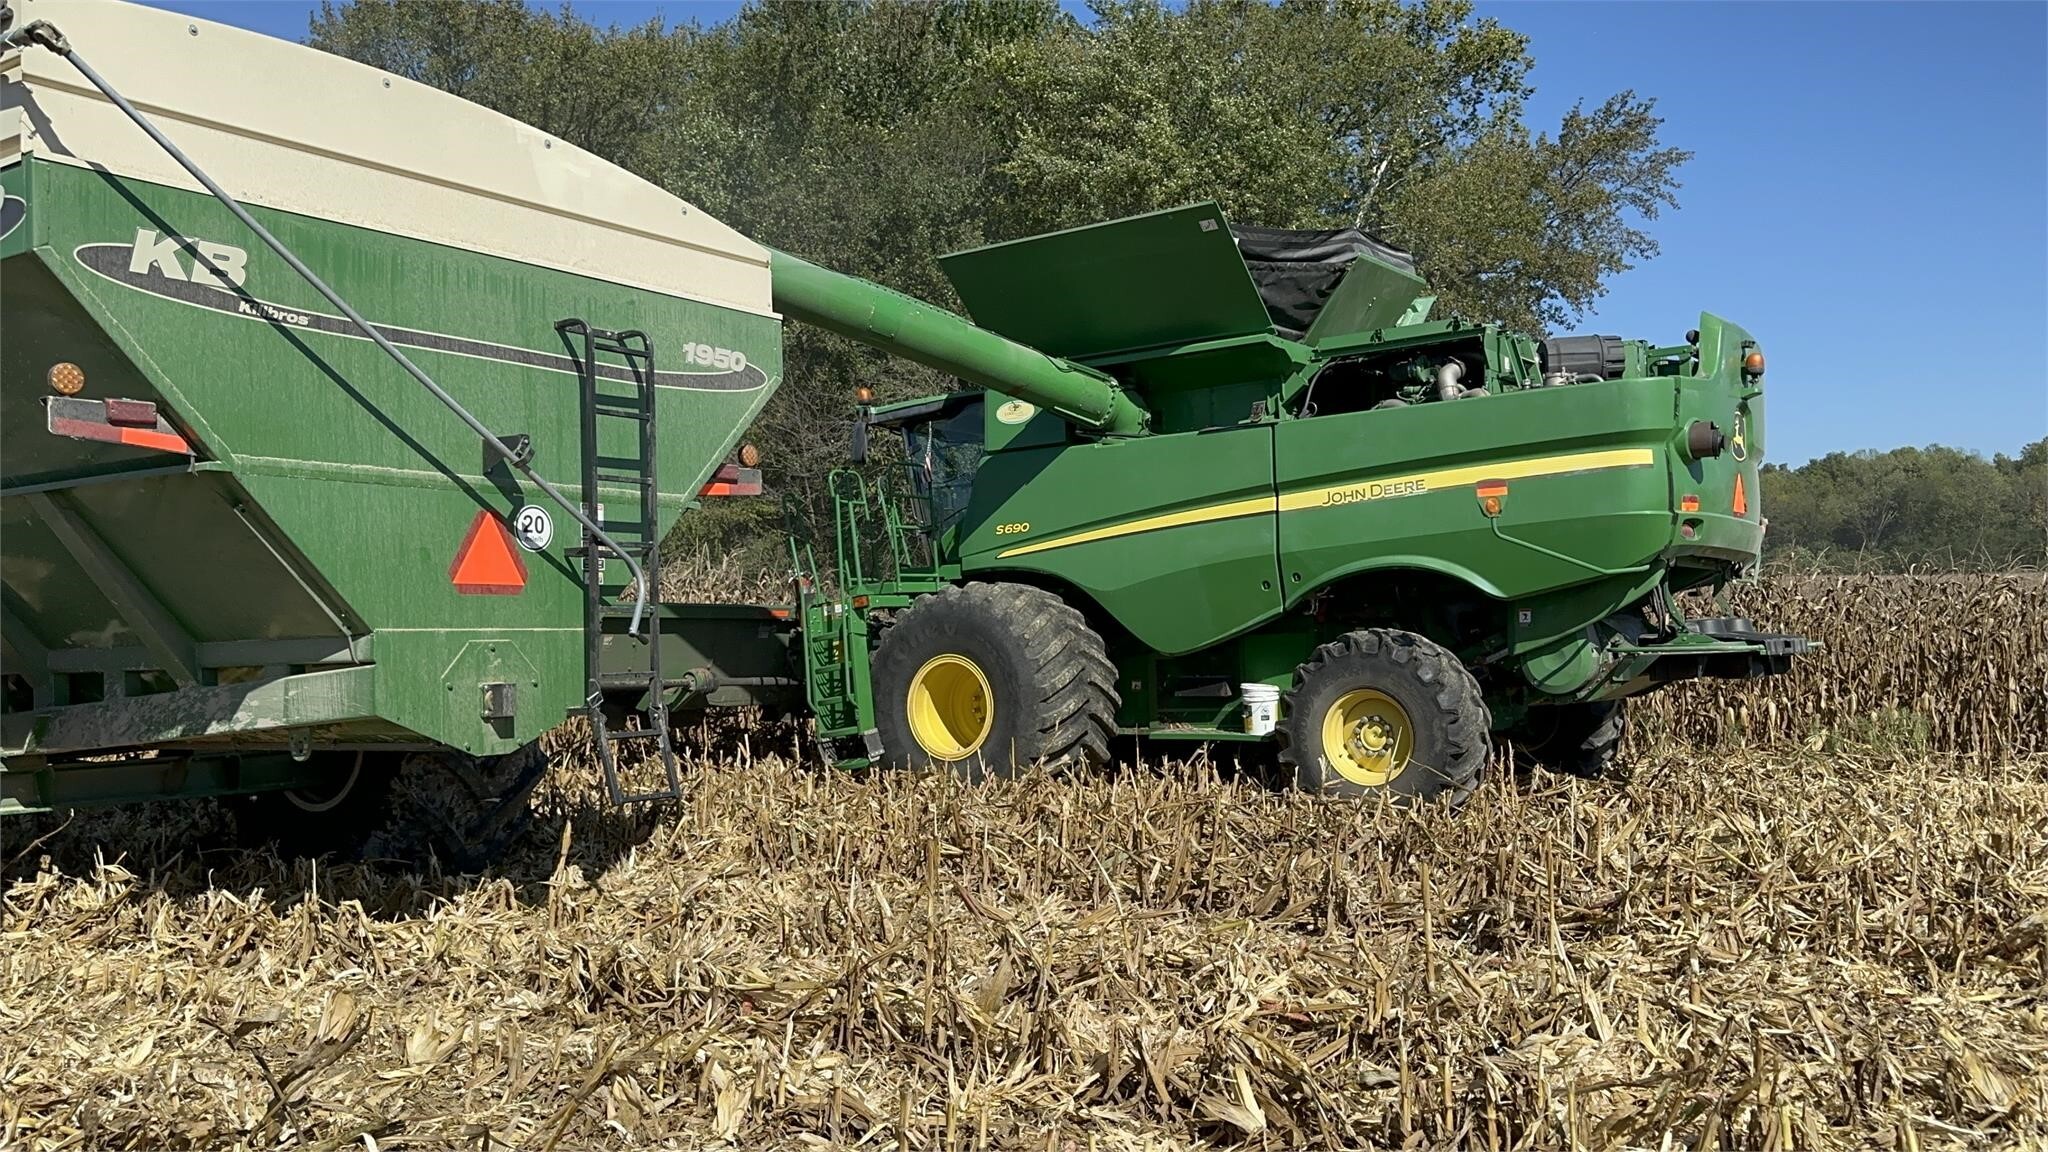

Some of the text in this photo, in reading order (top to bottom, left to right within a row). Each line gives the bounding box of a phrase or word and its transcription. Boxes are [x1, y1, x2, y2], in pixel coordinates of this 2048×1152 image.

[130, 227, 248, 287] KB
[683, 342, 746, 371] 1950
[1322, 479, 1426, 505] JOHN DEERE
[523, 515, 544, 534] 20
[996, 522, 1030, 535] S690
